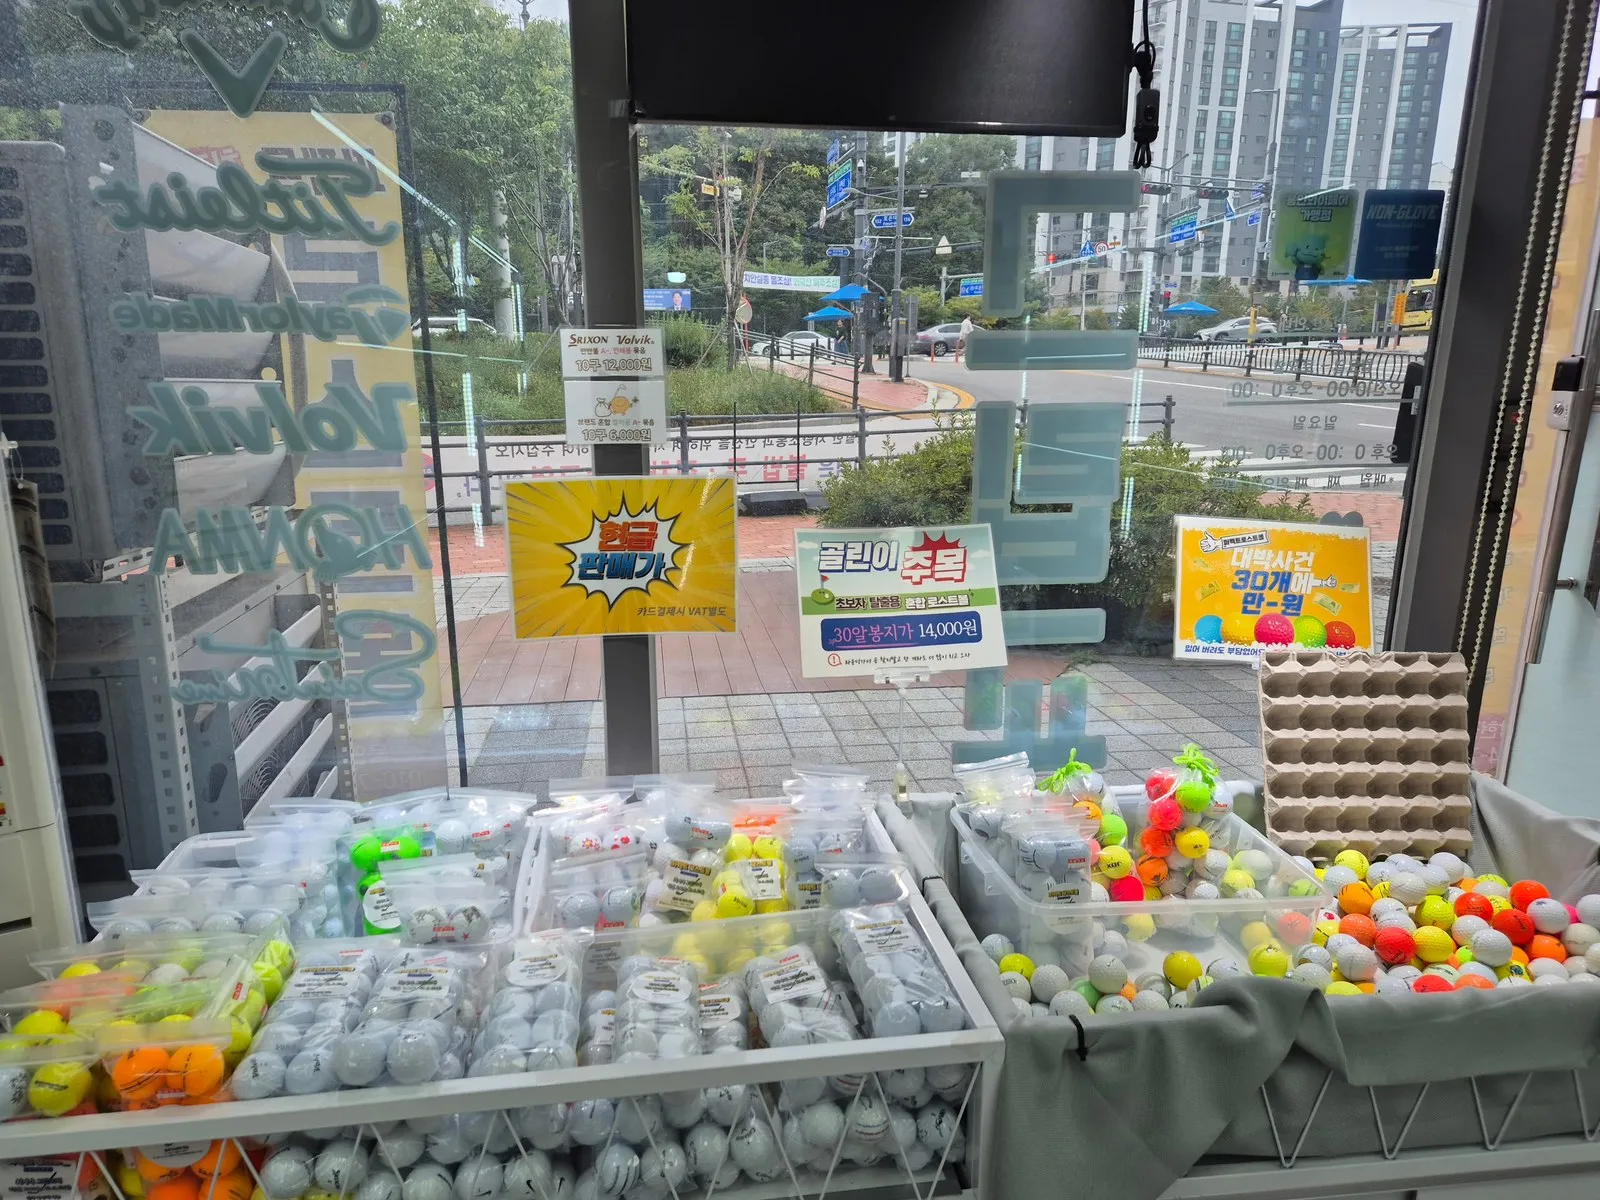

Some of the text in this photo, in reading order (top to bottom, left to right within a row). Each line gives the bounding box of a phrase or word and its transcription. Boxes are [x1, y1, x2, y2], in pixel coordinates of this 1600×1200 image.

[1097, 245, 1106, 253] 50
[616, 335, 651, 344] Volvik
[575, 358, 652, 372] 10구 12,000원
[581, 428, 652, 442] 10구 6,000원
[598, 521, 659, 552] 현금
[577, 552, 665, 580] 판매가
[818, 541, 968, 585] 골린이 주목
[1230, 548, 1315, 572] 대박사건
[1231, 570, 1316, 595] 30개에
[636, 606, 727, 617] 카드결제시 VAT별도
[835, 595, 970, 611] 초보자 탈출용 혼합 로스트볼
[868, 623, 914, 642] 봉지가
[919, 619, 978, 640] 14,000원
